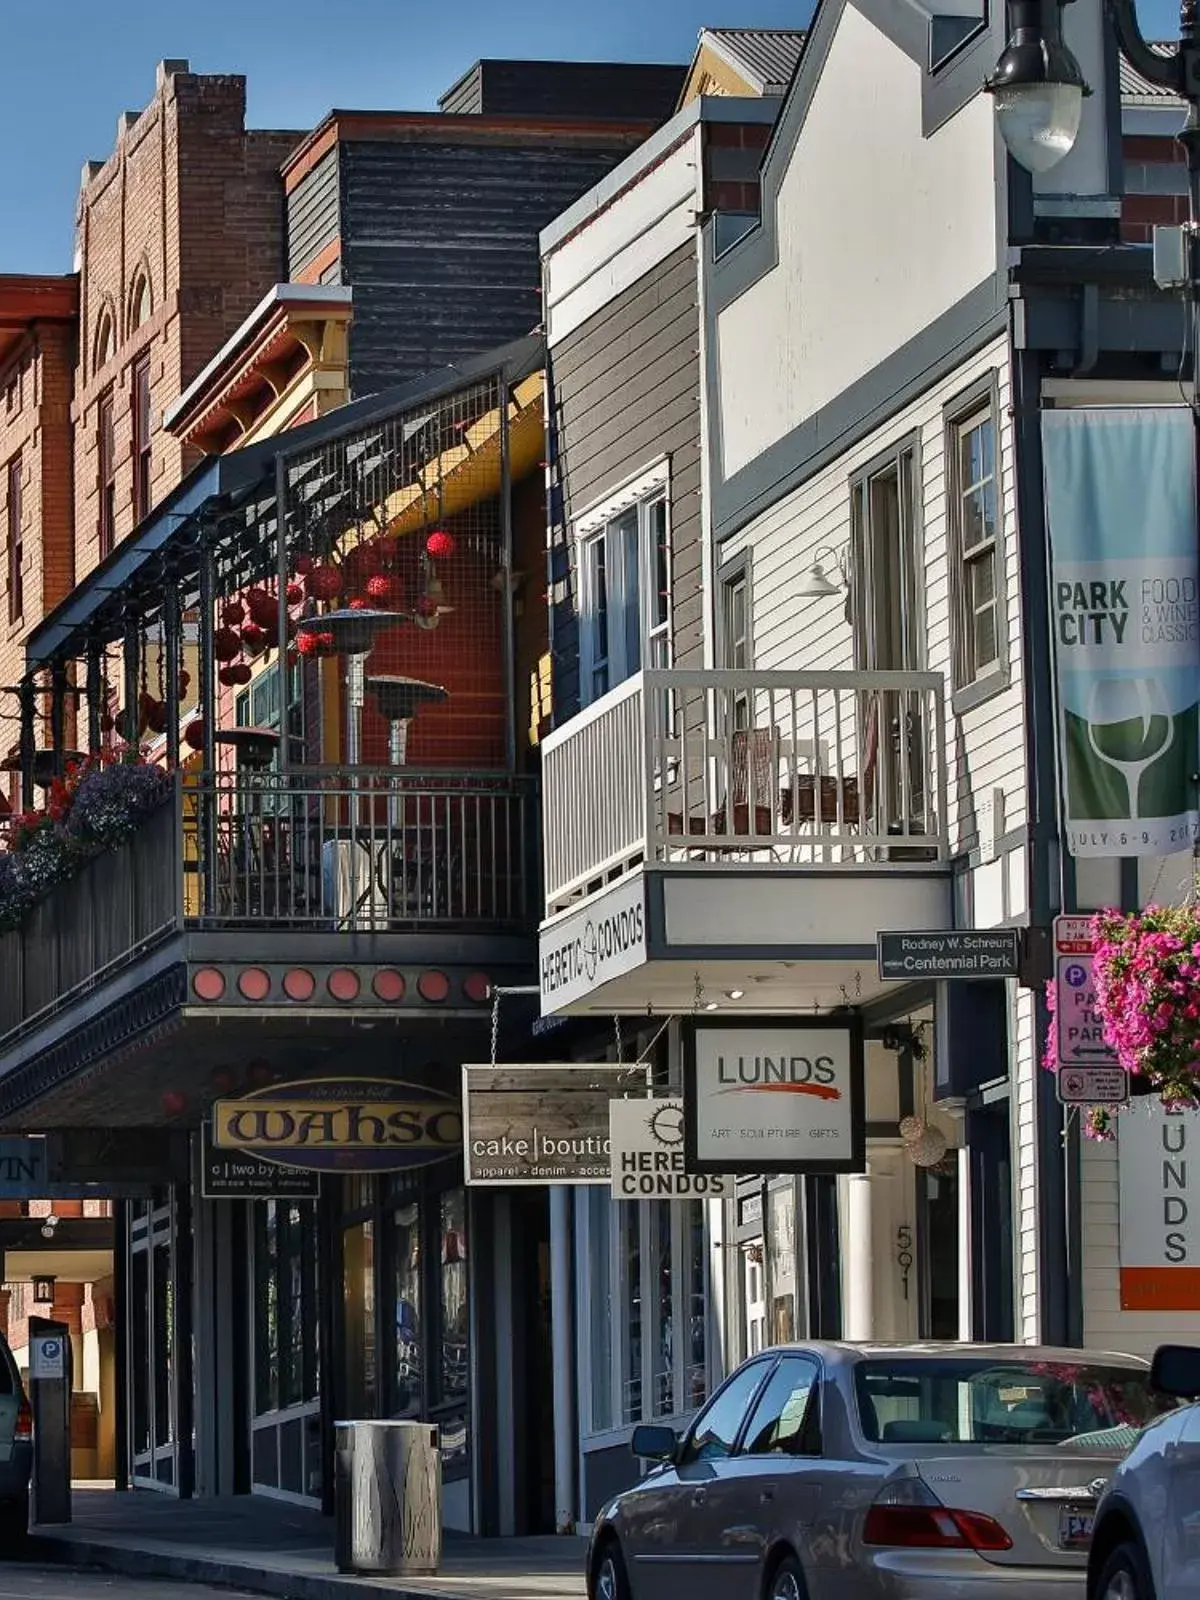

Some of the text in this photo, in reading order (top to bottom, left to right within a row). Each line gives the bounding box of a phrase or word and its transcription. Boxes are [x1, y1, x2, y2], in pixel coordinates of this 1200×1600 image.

[1057, 580, 1128, 610] PARK
[1141, 577, 1196, 604] FOOD
[1142, 603, 1197, 624] & WINE
[1060, 612, 1128, 645] CITY
[1142, 623, 1197, 643] CLASSIC
[1071, 832, 1108, 846] JULY
[541, 902, 643, 996] HERETIC CONDOS
[902, 937, 1013, 951] Rodney W. Schreurs
[904, 954, 1012, 970] Centennial Park
[717, 1056, 836, 1084] LUNDS
[710, 1128, 840, 1138] ART SCULPTURE GIFTS
[472, 1136, 529, 1156] cake
[231, 1164, 255, 1175] two
[259, 1163, 275, 1177] by
[621, 1151, 684, 1171] HERE
[475, 1167, 518, 1178] apparel
[531, 1166, 567, 1176] denim
[621, 1174, 724, 1194] CONDOS
[1162, 1110, 1188, 1263] UNDS
[897, 1226, 913, 1300] 591
